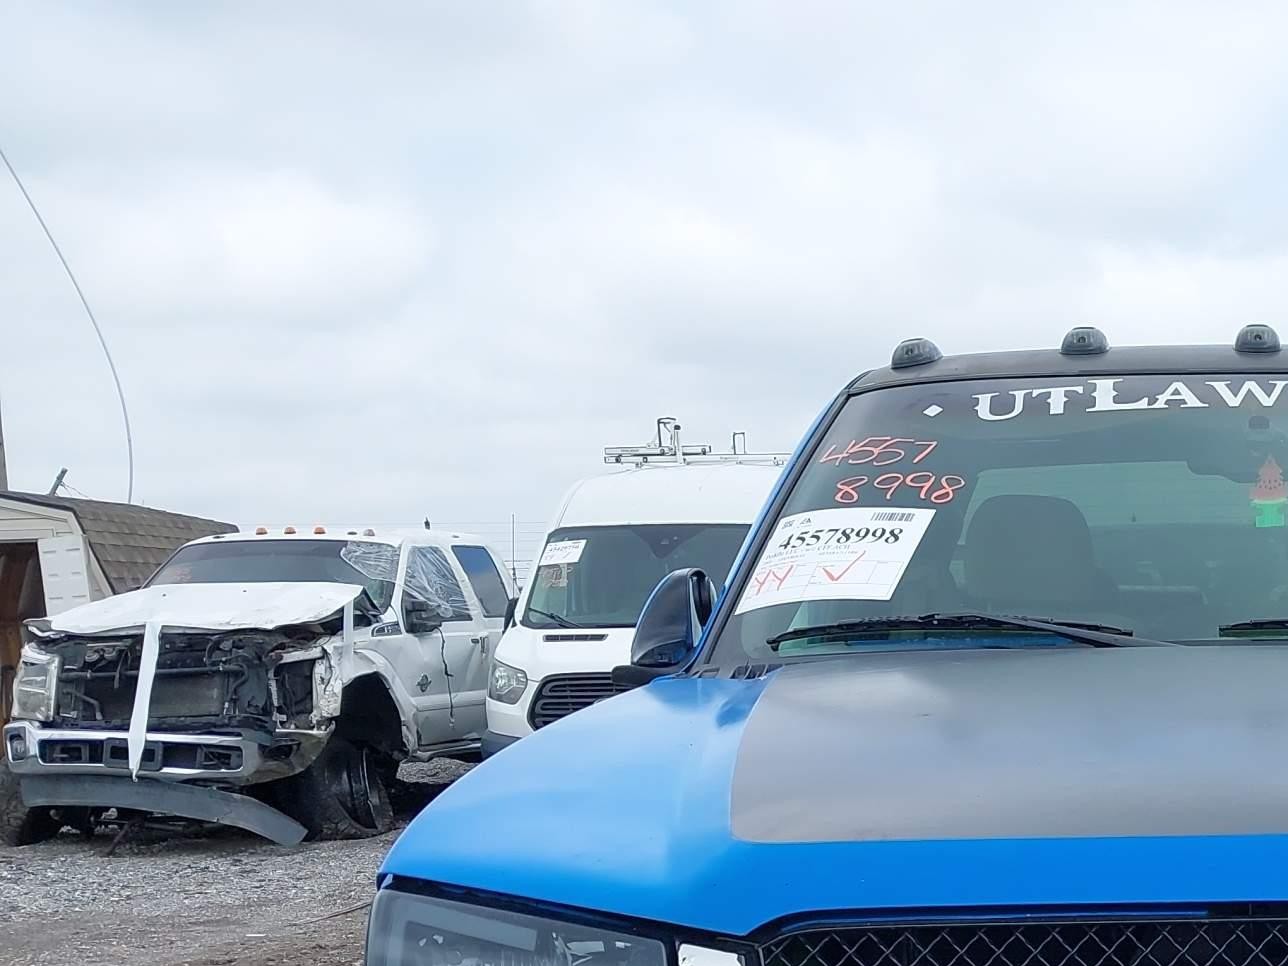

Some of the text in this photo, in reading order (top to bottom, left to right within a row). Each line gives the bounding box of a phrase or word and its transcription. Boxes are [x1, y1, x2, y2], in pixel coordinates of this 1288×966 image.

[819, 436, 938, 466] 4557
[834, 471, 966, 504] 8998
[778, 527, 904, 550] 45578998
